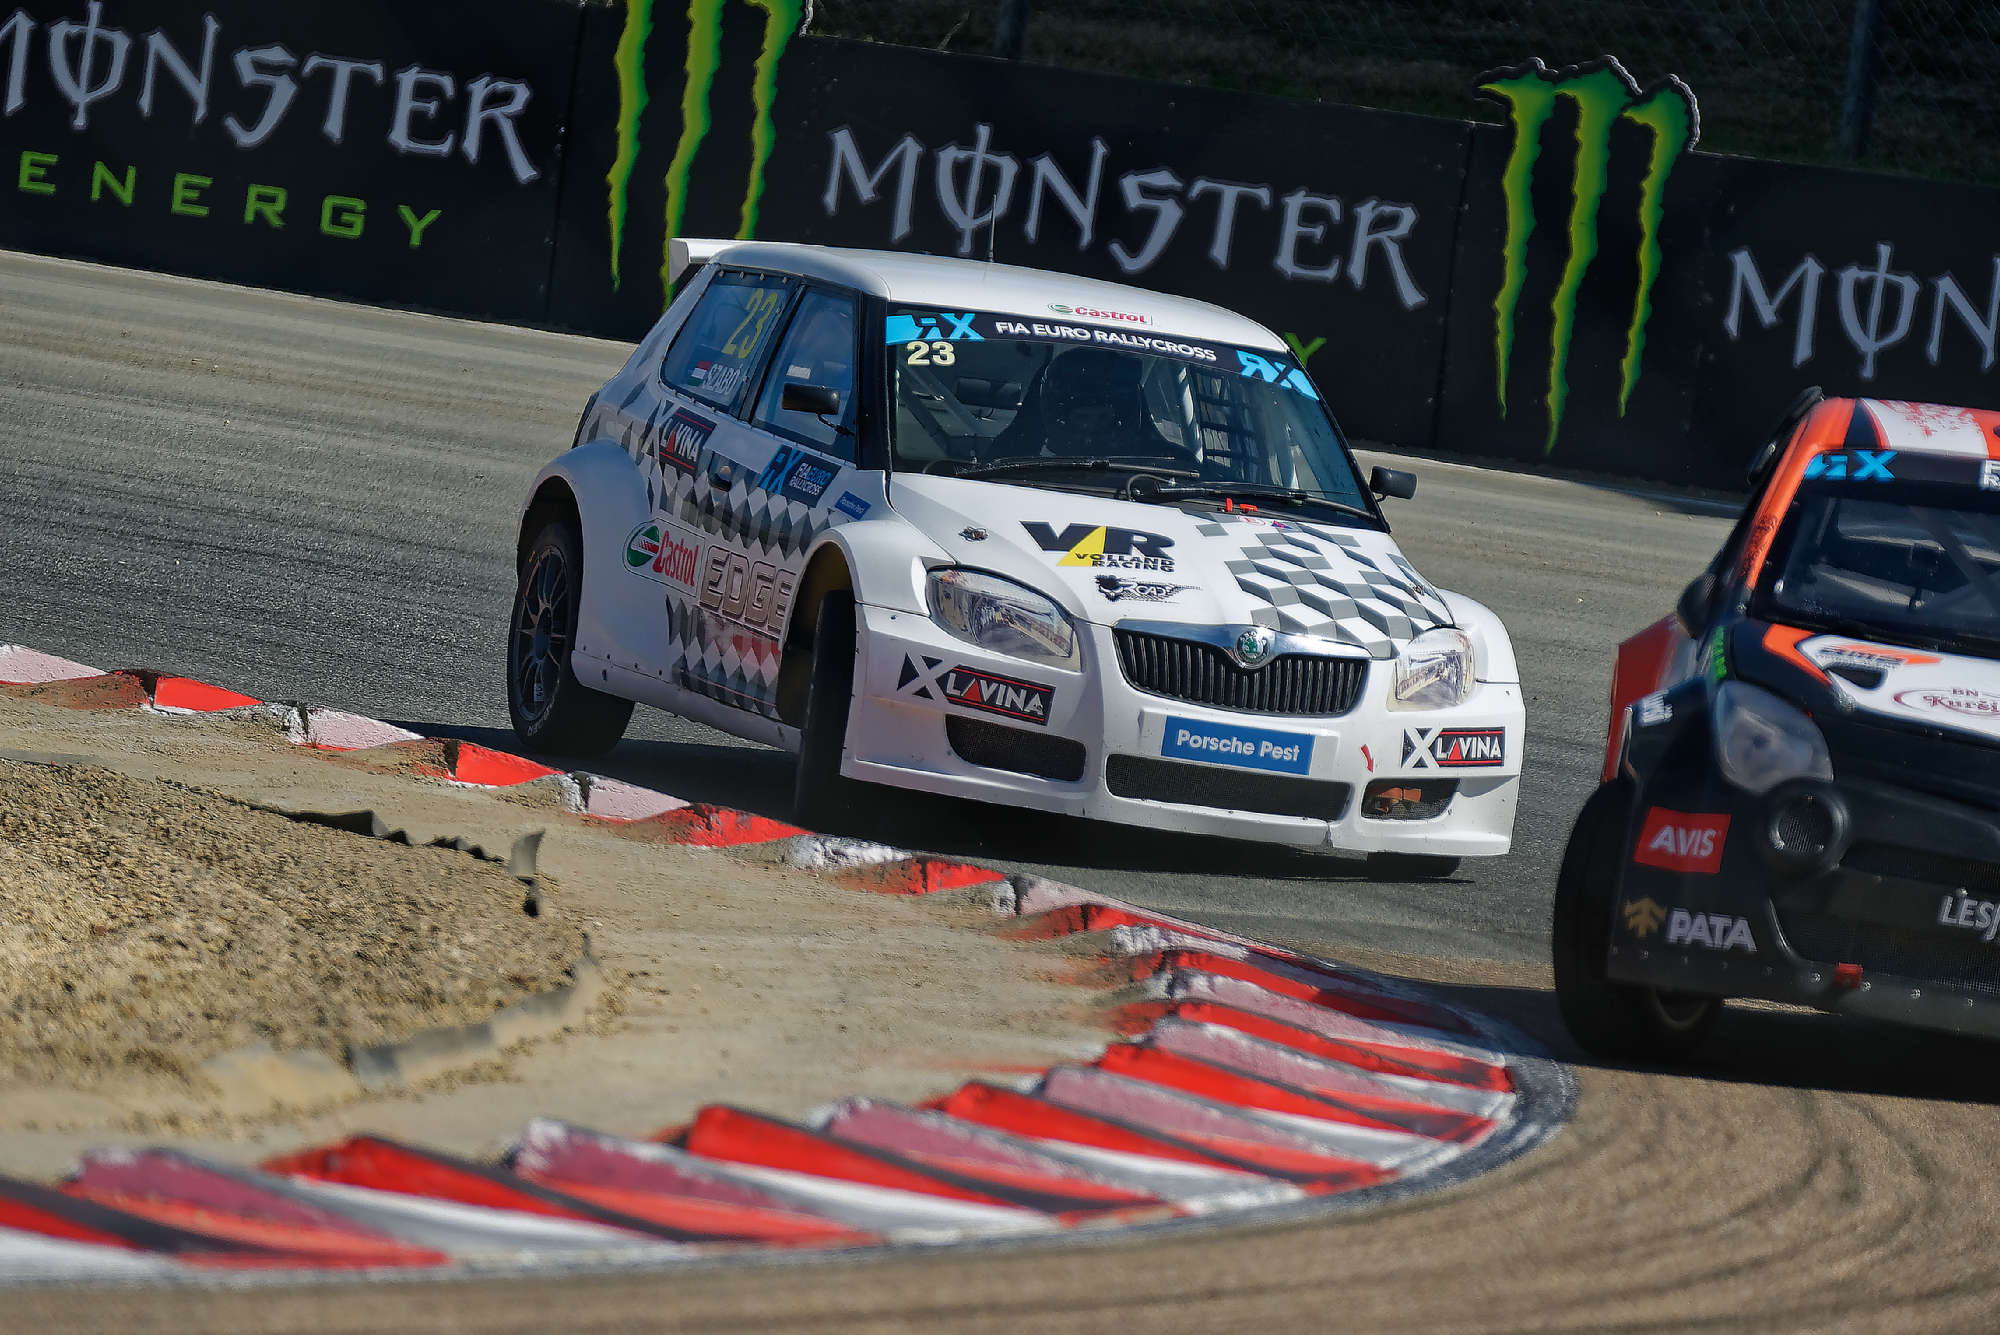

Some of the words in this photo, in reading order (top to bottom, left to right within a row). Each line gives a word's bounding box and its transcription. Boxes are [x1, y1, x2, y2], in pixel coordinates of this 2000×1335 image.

[17, 150, 443, 249] ENERGY
[822, 121, 1429, 310] MONSTER
[720, 288, 779, 360] 23
[1074, 307, 1148, 324] Castrol
[905, 340, 956, 367] 23
[995, 321, 1031, 335] FIA
[1032, 323, 1092, 341] EURO
[1093, 330, 1217, 362] RALLYCROSS
[653, 530, 699, 588] Castrol
[1074, 552, 1176, 566] VOLLAND
[1091, 560, 1176, 573] RACING
[699, 545, 798, 635] EDGE
[1177, 728, 1255, 756] Porsche
[1259, 739, 1300, 763] Pest
[1649, 824, 1717, 858] AVIS
[1665, 907, 1758, 953] PATA
